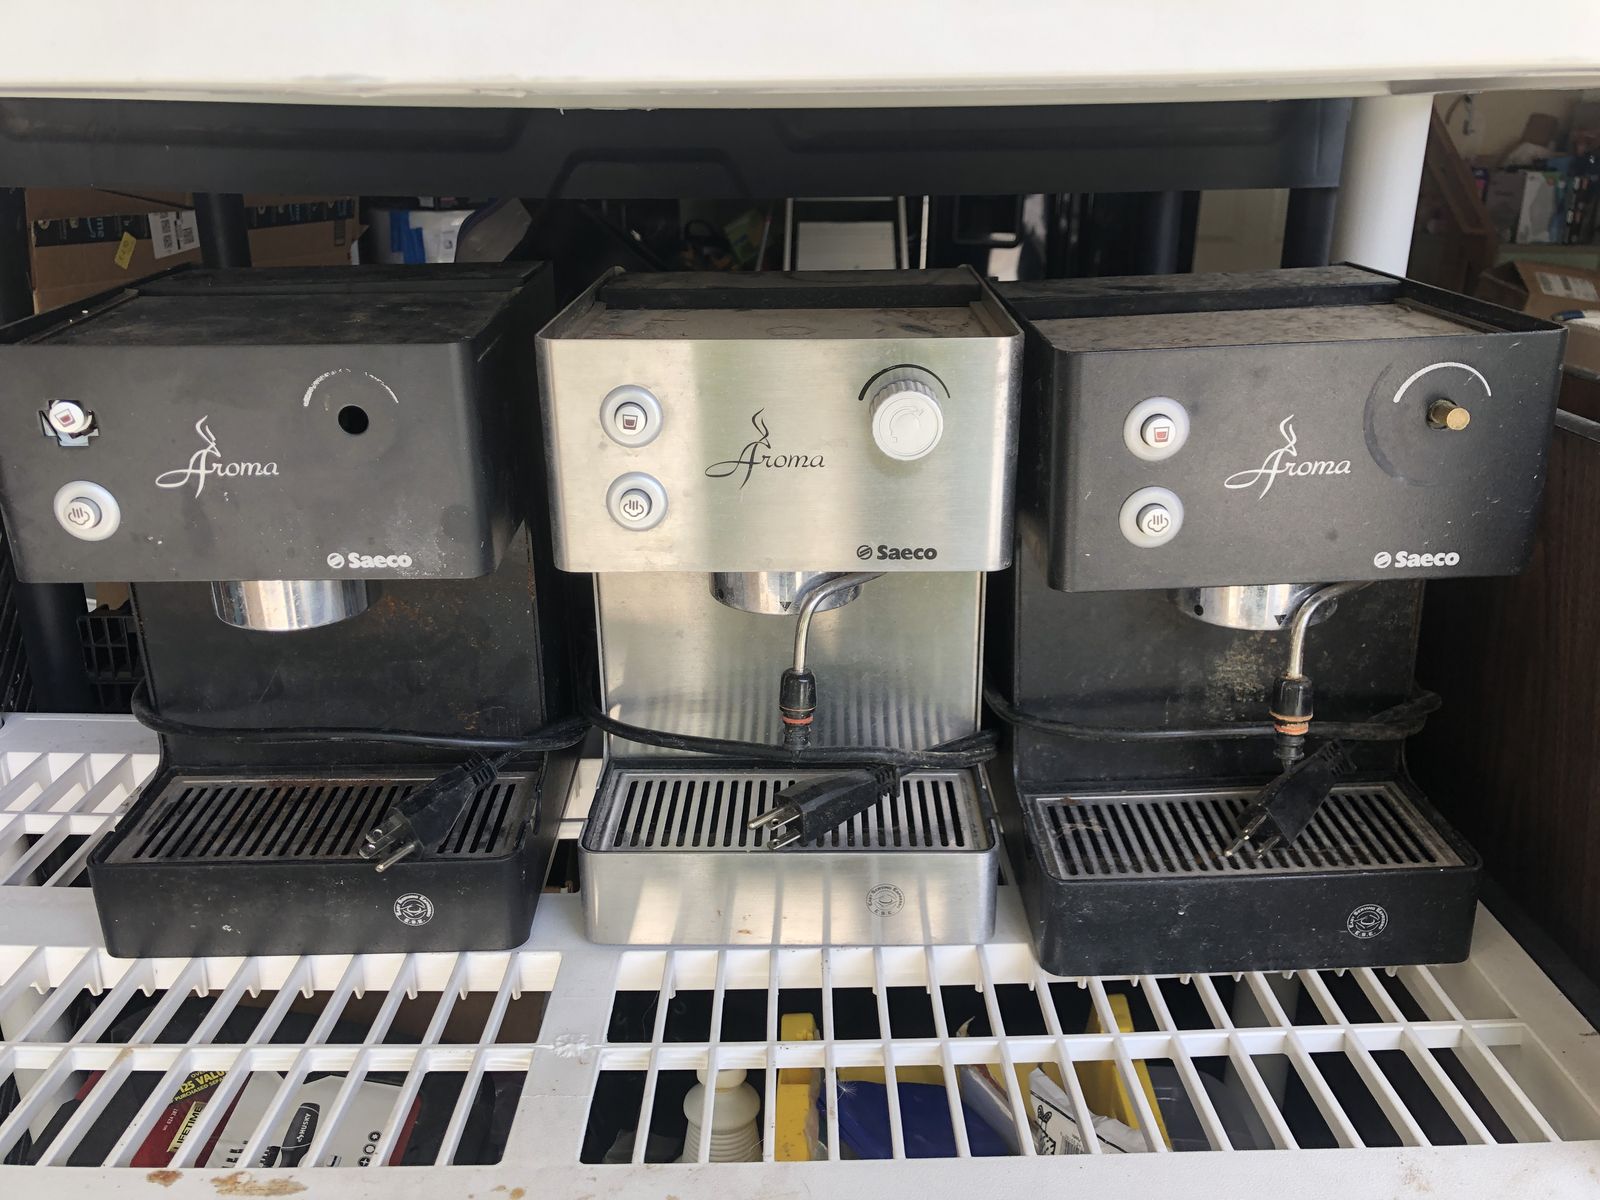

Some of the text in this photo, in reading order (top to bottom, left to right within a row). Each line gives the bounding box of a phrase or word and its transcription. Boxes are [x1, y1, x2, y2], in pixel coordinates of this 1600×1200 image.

[155, 440, 280, 499] Aroma
[704, 436, 826, 490] Aroma
[1224, 442, 1351, 500] Aroma
[348, 552, 413, 569] Saeco
[876, 544, 938, 560] Saeco
[1394, 550, 1461, 568] Saeco
[196, 1071, 227, 1085] VALU
[300, 1113, 311, 1136] HUSKY
